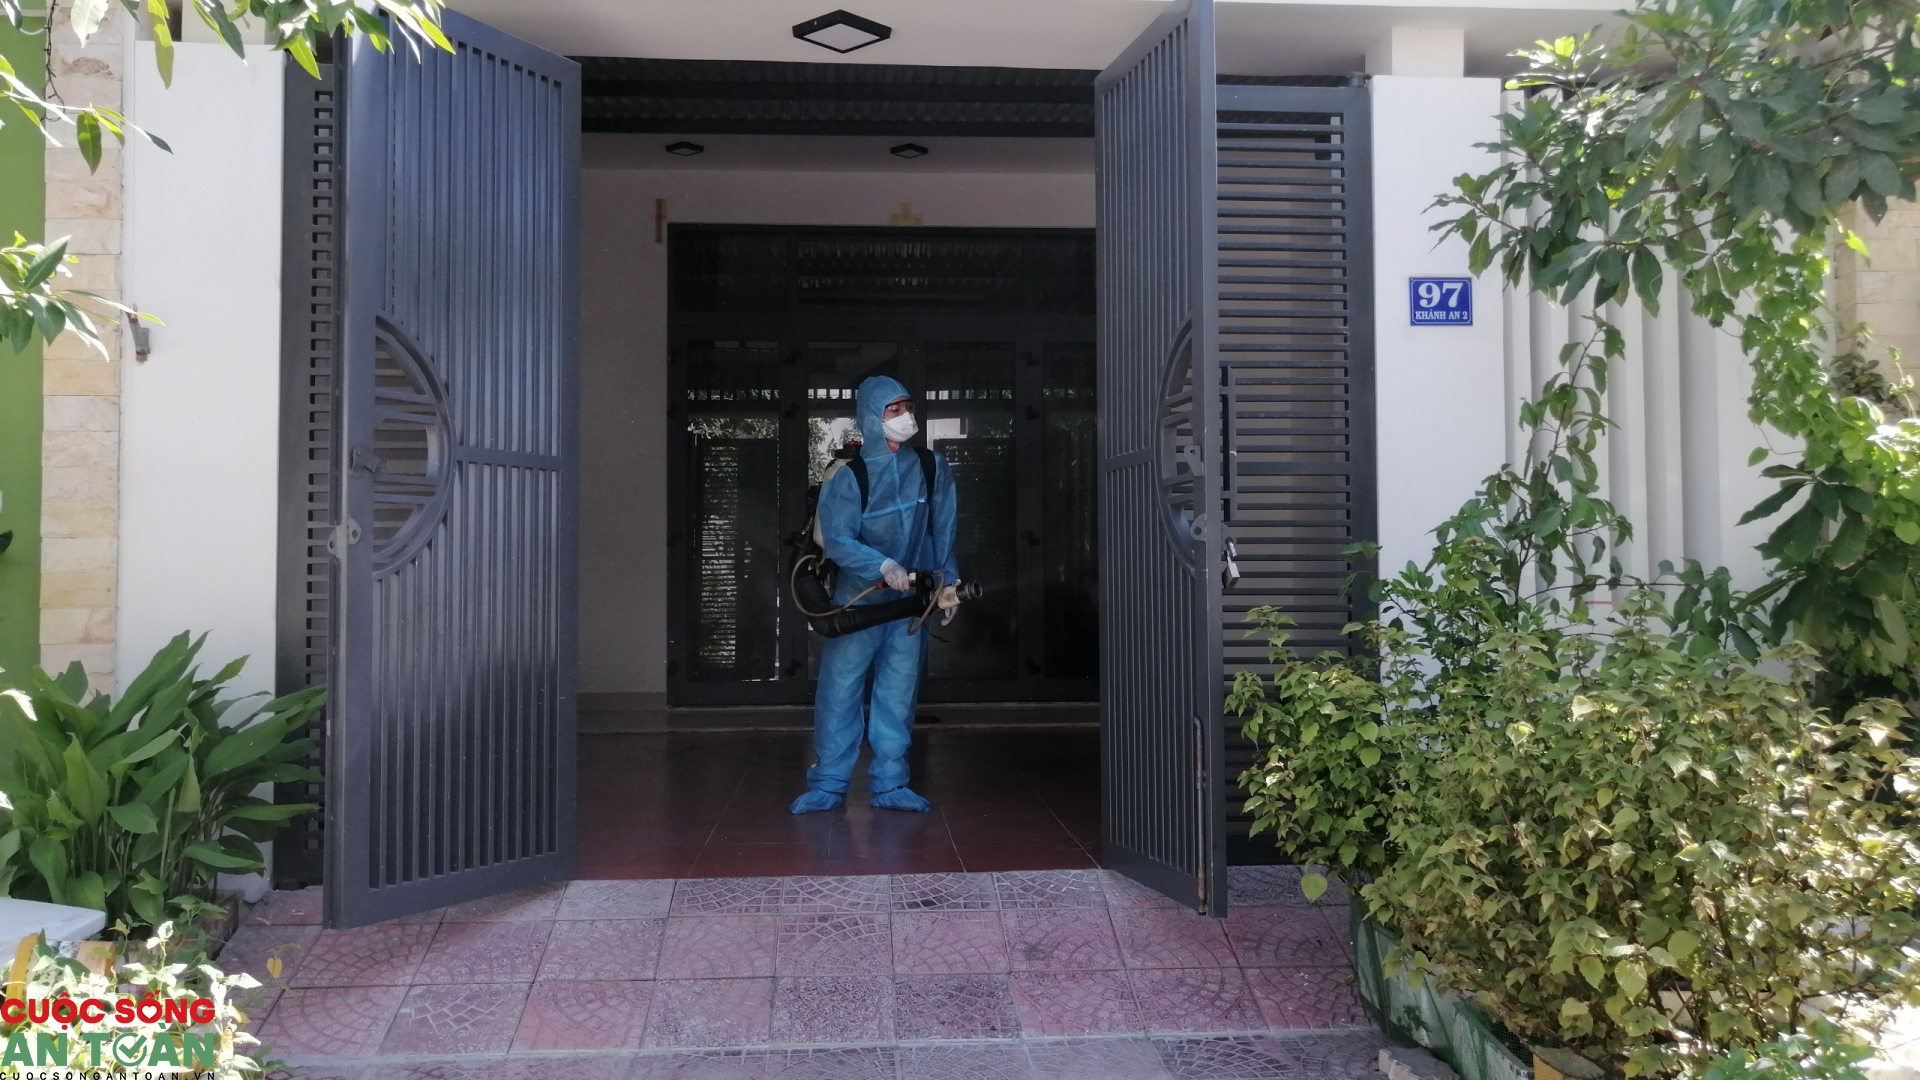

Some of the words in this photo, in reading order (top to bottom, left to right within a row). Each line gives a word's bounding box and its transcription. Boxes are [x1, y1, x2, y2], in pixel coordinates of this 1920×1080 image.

[1418, 282, 1463, 308] 97
[1415, 309, 1446, 320] KHÁNH
[1448, 311, 1460, 320] AN
[1462, 311, 1468, 320] 2
